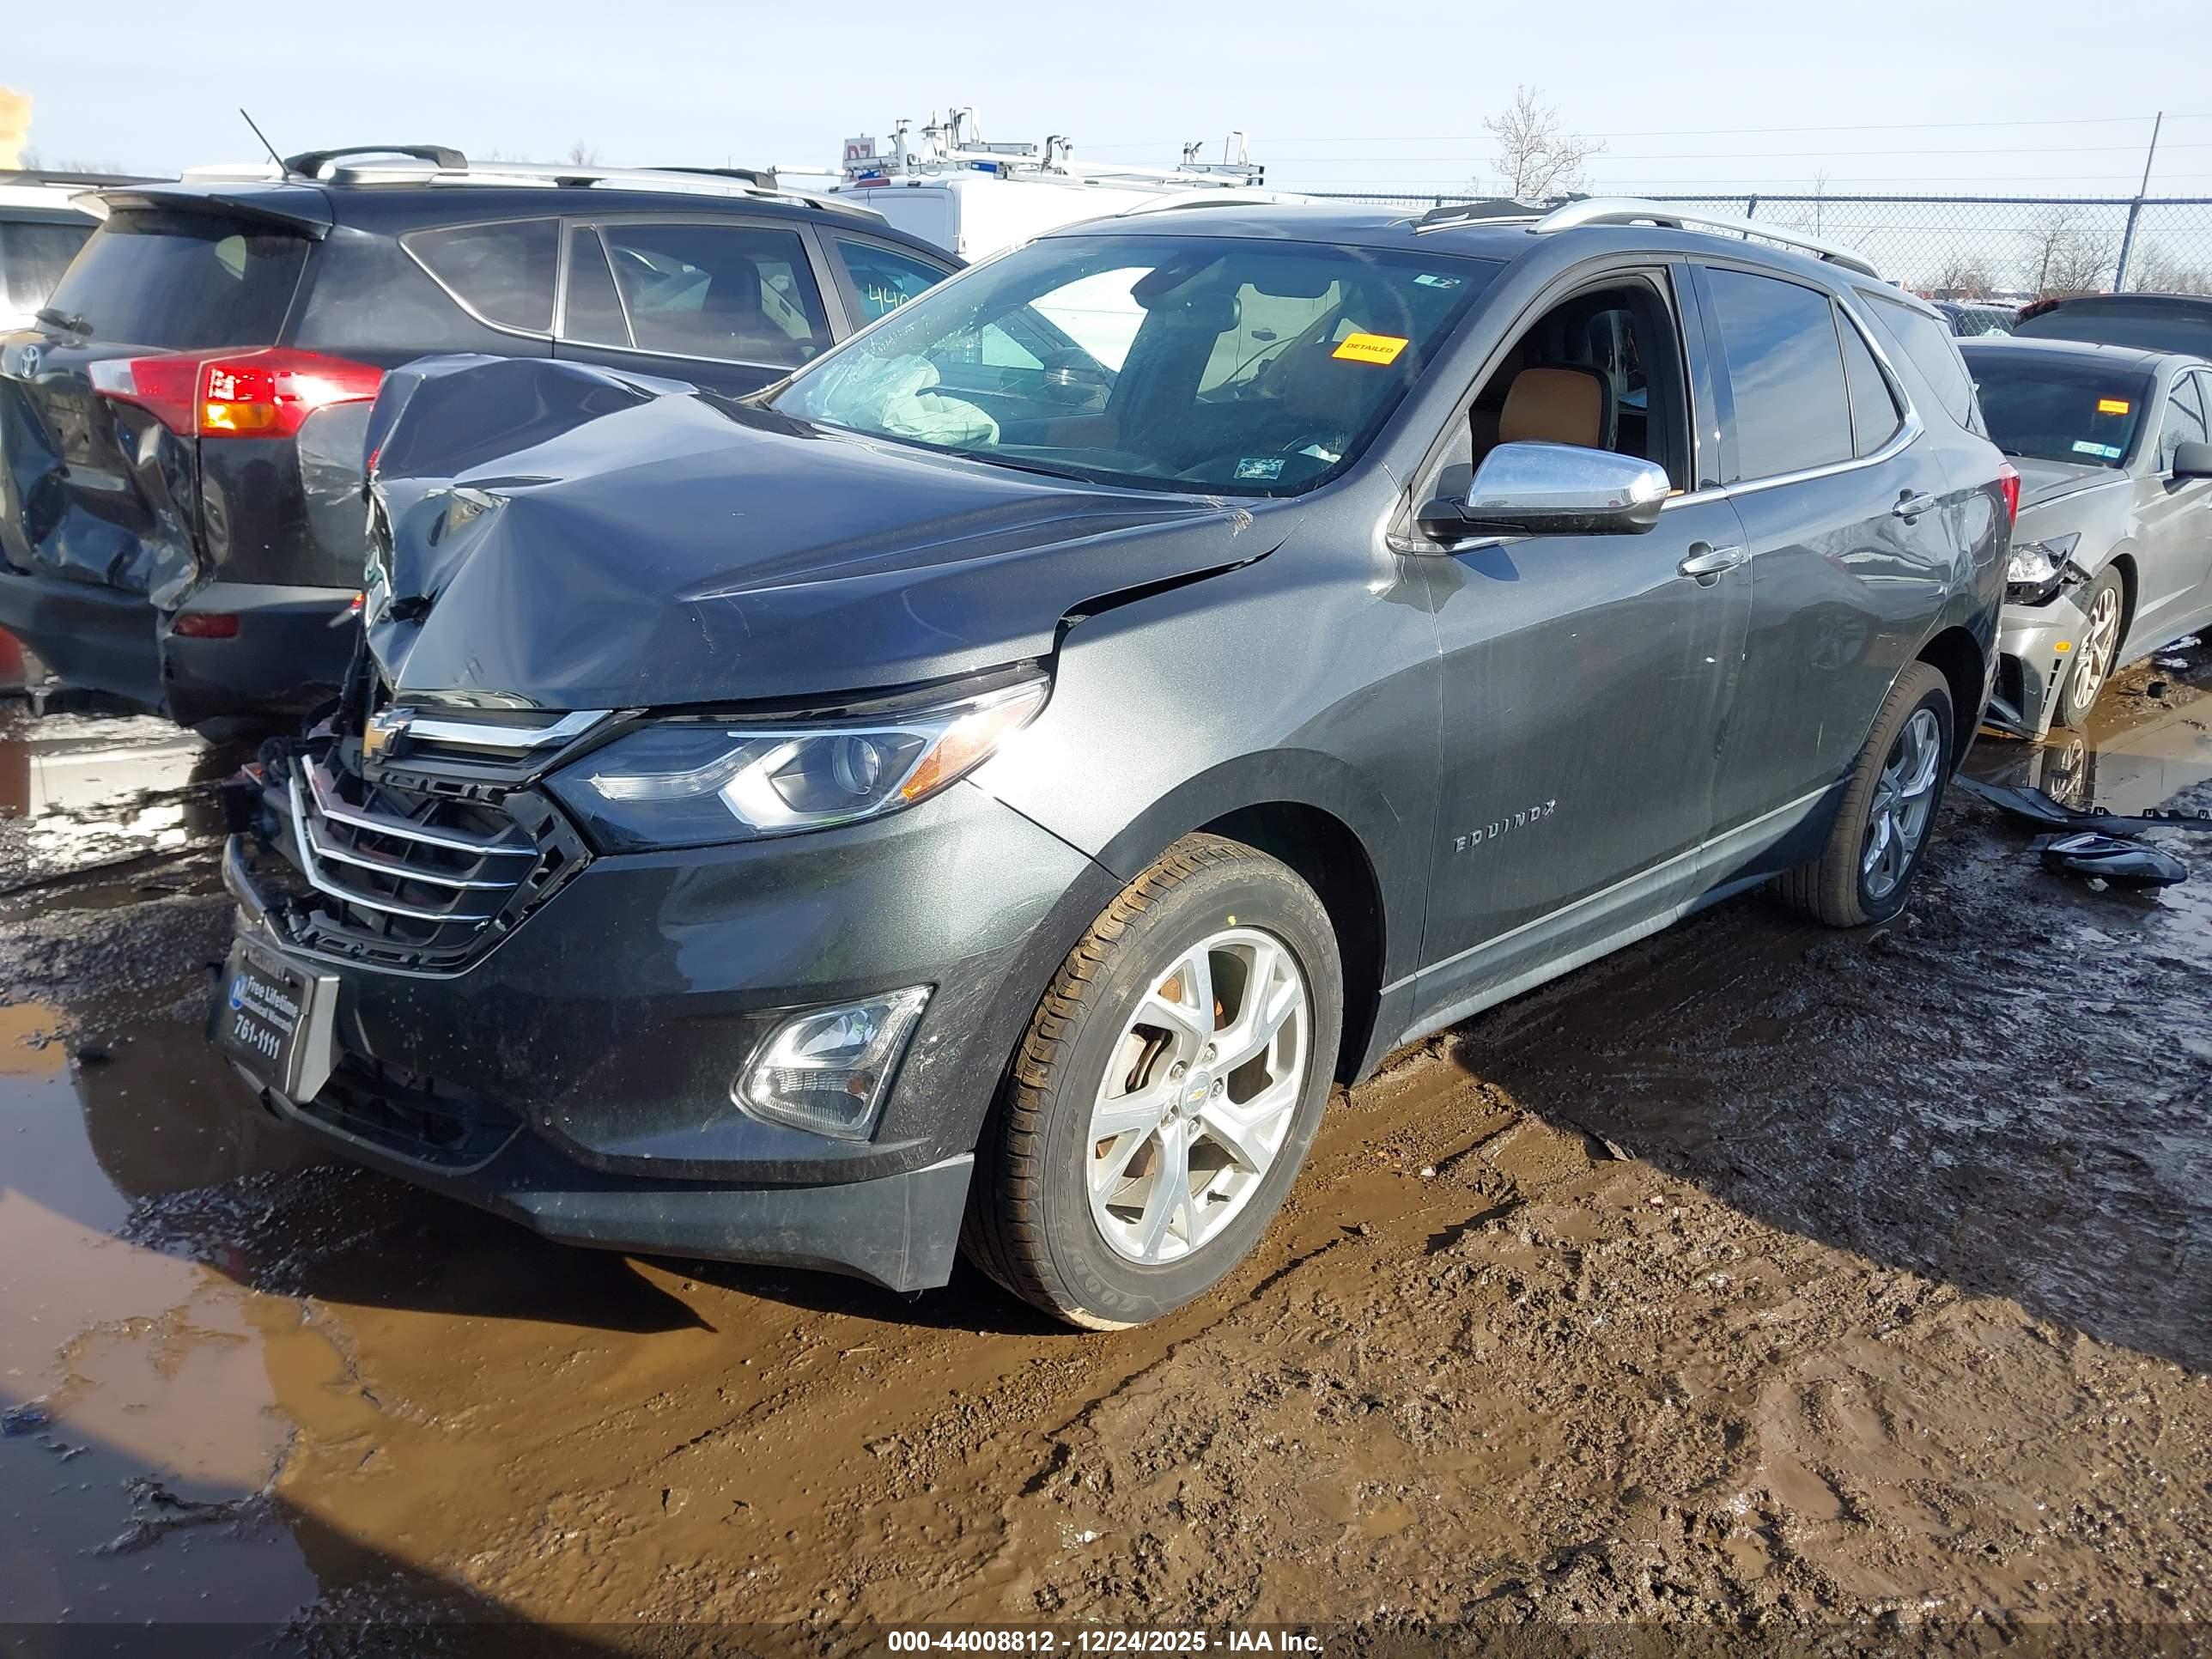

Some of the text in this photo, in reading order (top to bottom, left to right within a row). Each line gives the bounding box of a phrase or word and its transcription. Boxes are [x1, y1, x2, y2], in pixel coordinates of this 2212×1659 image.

[1346, 343, 1394, 353] DETAILED
[1453, 799, 1557, 853] EQUINOX
[247, 975, 299, 1018] Free Lifetime
[234, 1013, 280, 1060] 761-1111
